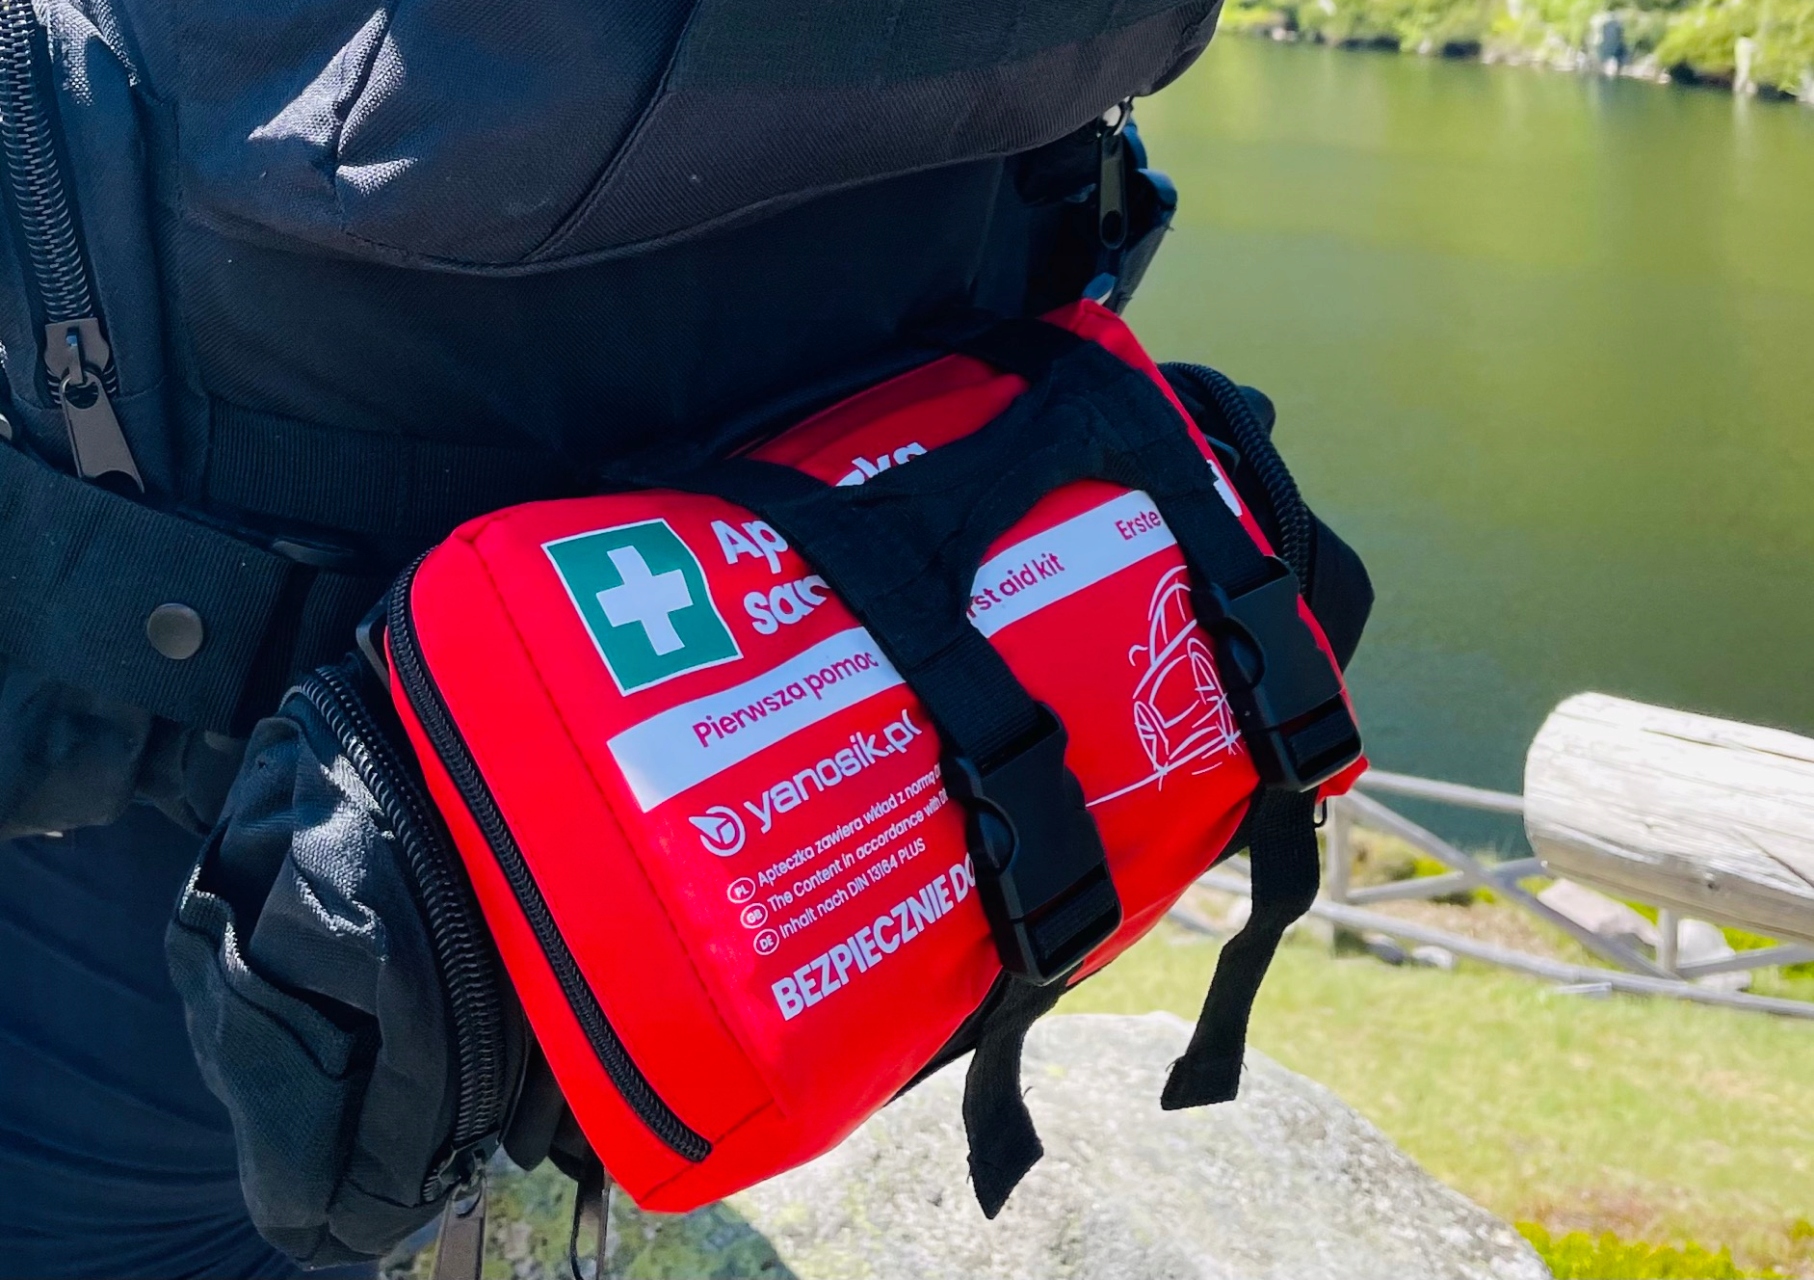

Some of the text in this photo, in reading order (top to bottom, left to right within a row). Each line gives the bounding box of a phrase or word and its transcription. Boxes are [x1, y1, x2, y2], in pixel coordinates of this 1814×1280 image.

[1114, 510, 1162, 541] Erste
[966, 552, 1065, 619] rst aid kit
[692, 651, 879, 748] Pierwsza pomoc
[743, 709, 923, 834] yanosik.pl
[757, 846, 815, 887] Apteczka
[814, 817, 864, 854] zawiera
[896, 791, 906, 805] z
[767, 891, 793, 912] The
[793, 859, 843, 897] Content
[841, 853, 856, 869] in
[856, 810, 924, 860] accordance
[923, 796, 942, 817] with
[779, 907, 817, 939] Inhalt
[816, 889, 849, 916] nach
[847, 873, 869, 897] DIN
[867, 854, 898, 882] 13164
[897, 838, 926, 864] PLUS
[771, 874, 954, 1021] BEZPIECZNIE
